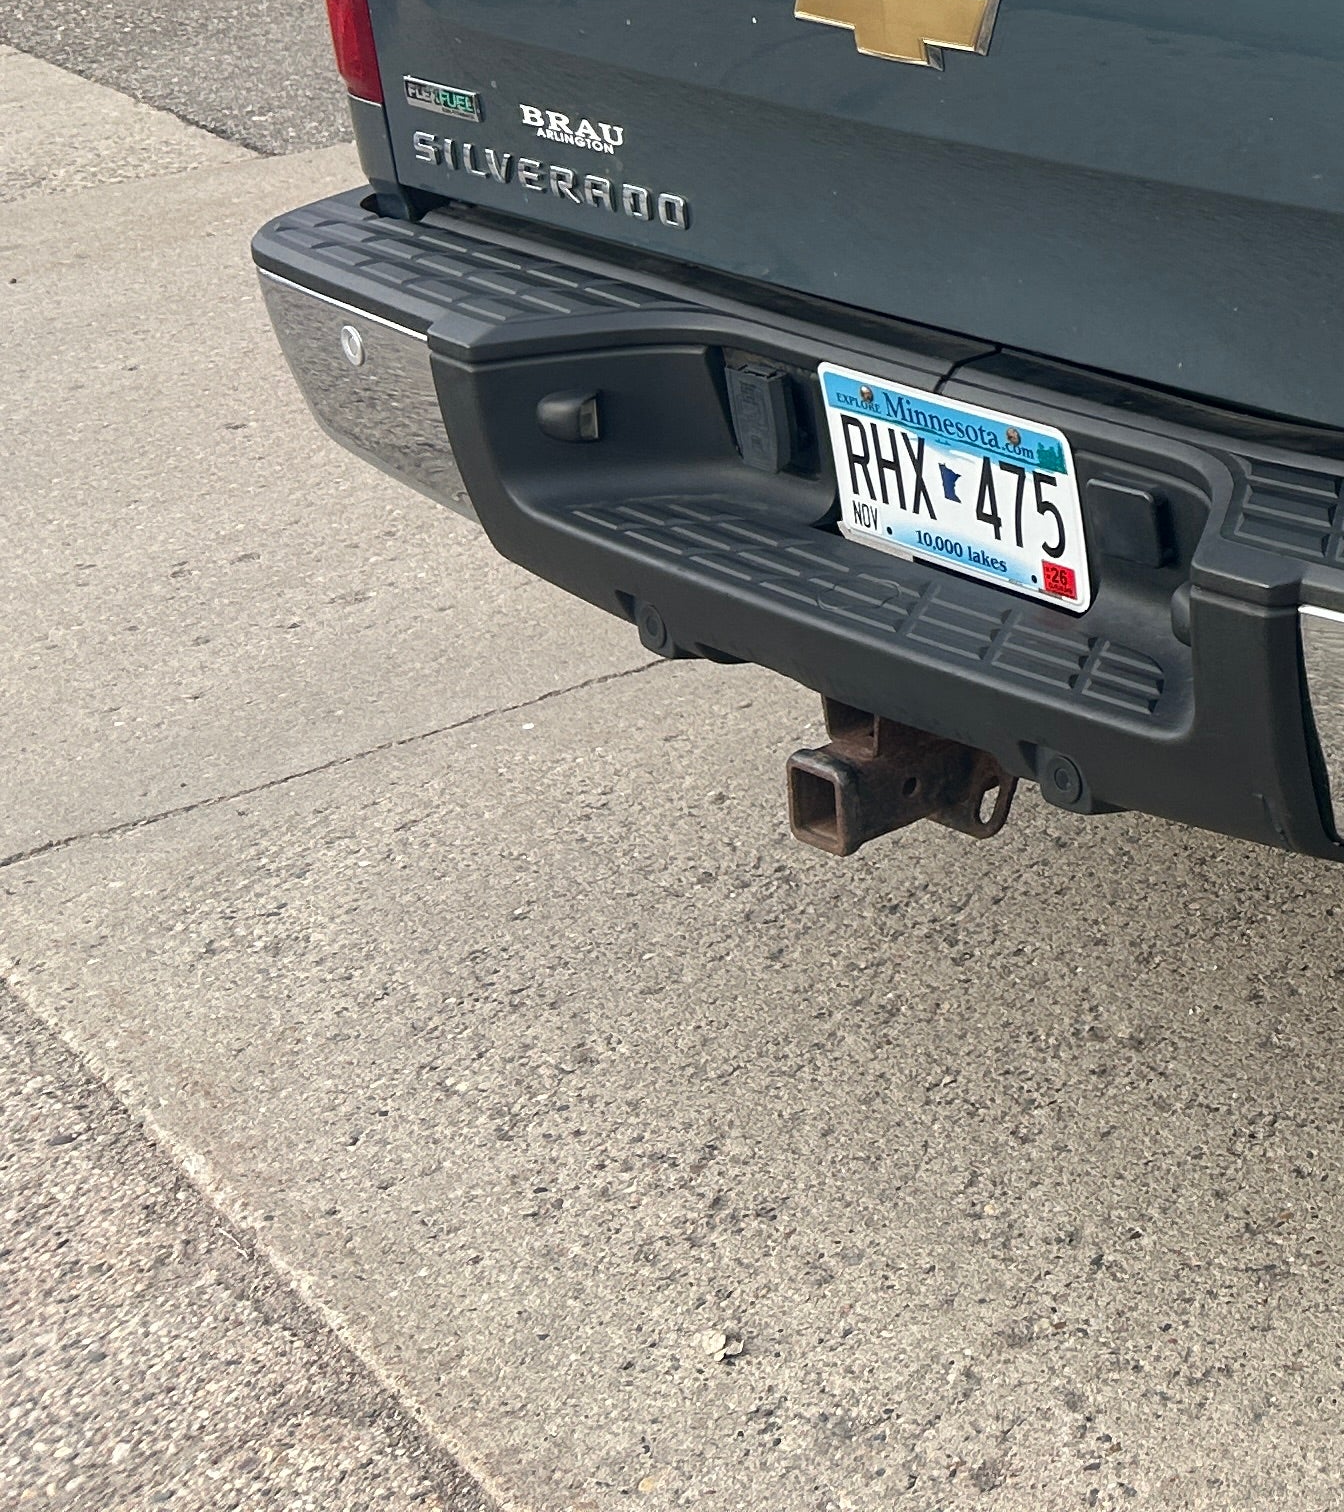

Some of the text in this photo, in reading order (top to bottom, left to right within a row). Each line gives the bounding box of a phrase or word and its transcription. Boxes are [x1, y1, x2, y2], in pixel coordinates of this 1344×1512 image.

[519, 103, 624, 147] BRAU
[536, 126, 615, 155] ARLINGTON
[412, 130, 689, 231] SILVERADO
[836, 392, 882, 415] EXPLORE
[840, 413, 1067, 559] RHX 475
[852, 499, 879, 531] NOV
[967, 545, 1008, 573] lakes
[1050, 566, 1069, 587] 26
